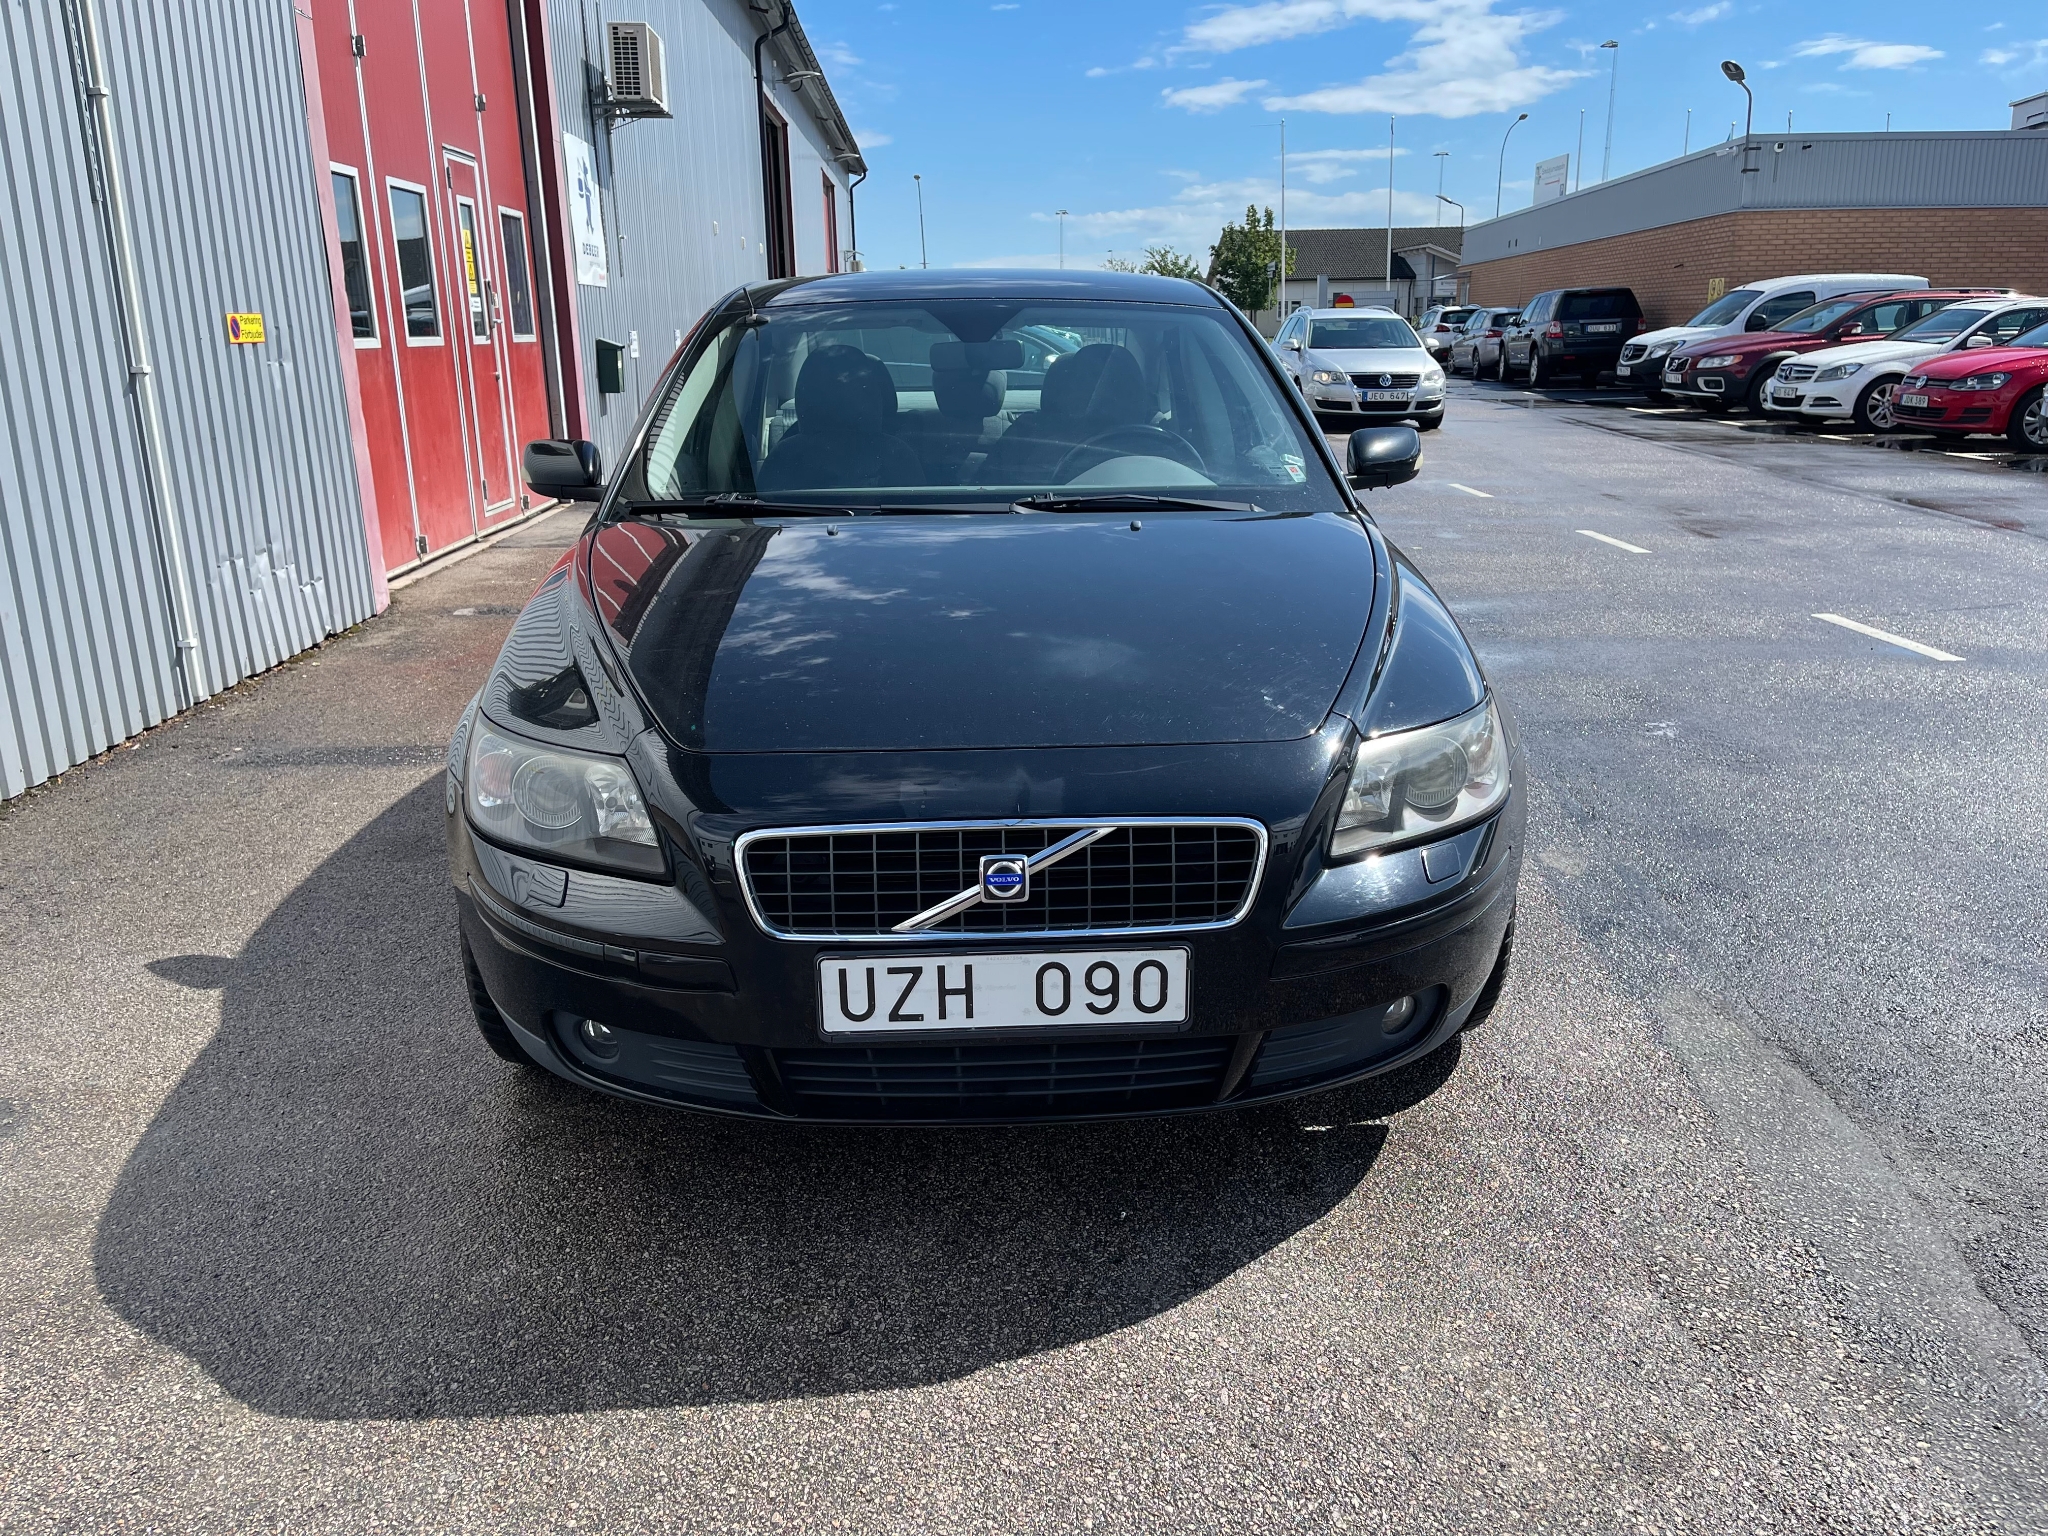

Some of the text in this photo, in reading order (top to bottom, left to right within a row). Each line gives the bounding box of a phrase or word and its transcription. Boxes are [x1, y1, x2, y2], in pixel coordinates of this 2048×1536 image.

[239, 315, 262, 328] Parkering
[241, 329, 264, 341] Förbjuden
[1368, 392, 1406, 400] JEO 647
[838, 958, 1169, 1022] UZH 090
